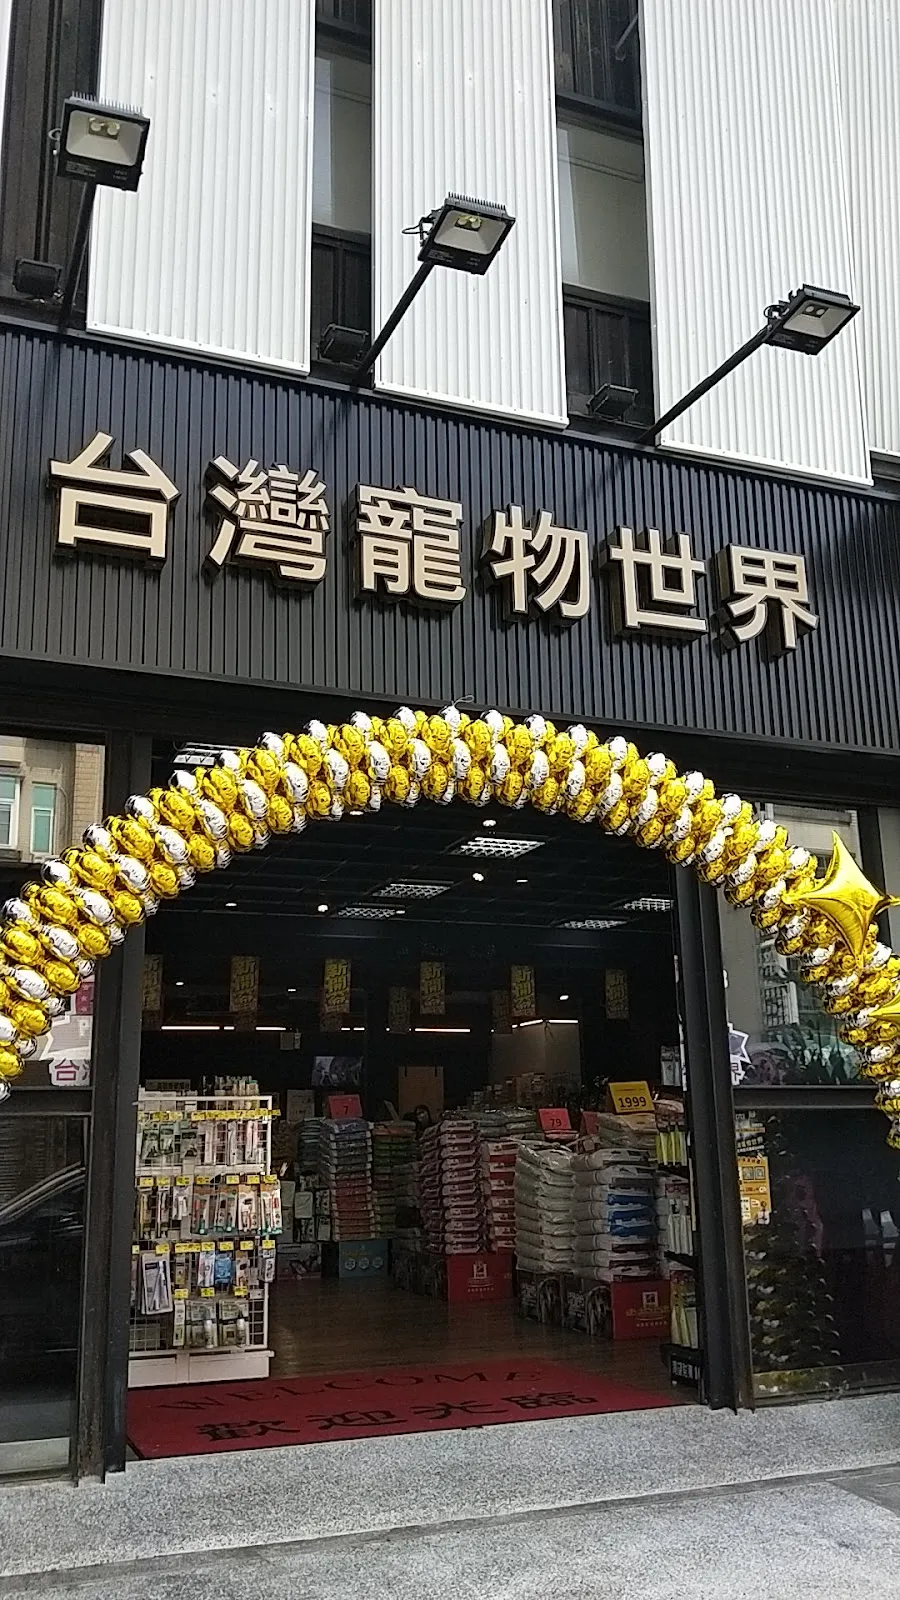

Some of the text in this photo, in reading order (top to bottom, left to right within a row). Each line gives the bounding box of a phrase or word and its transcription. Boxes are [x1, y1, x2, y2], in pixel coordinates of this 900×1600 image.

[50, 431, 820, 650] 台灣寵物世界
[55, 1058, 90, 1081] 台
[618, 1096, 647, 1108] 1999
[549, 1118, 562, 1128] 79
[158, 1371, 542, 1410] WELCOME
[196, 1391, 599, 1441] 歡迎光臨
